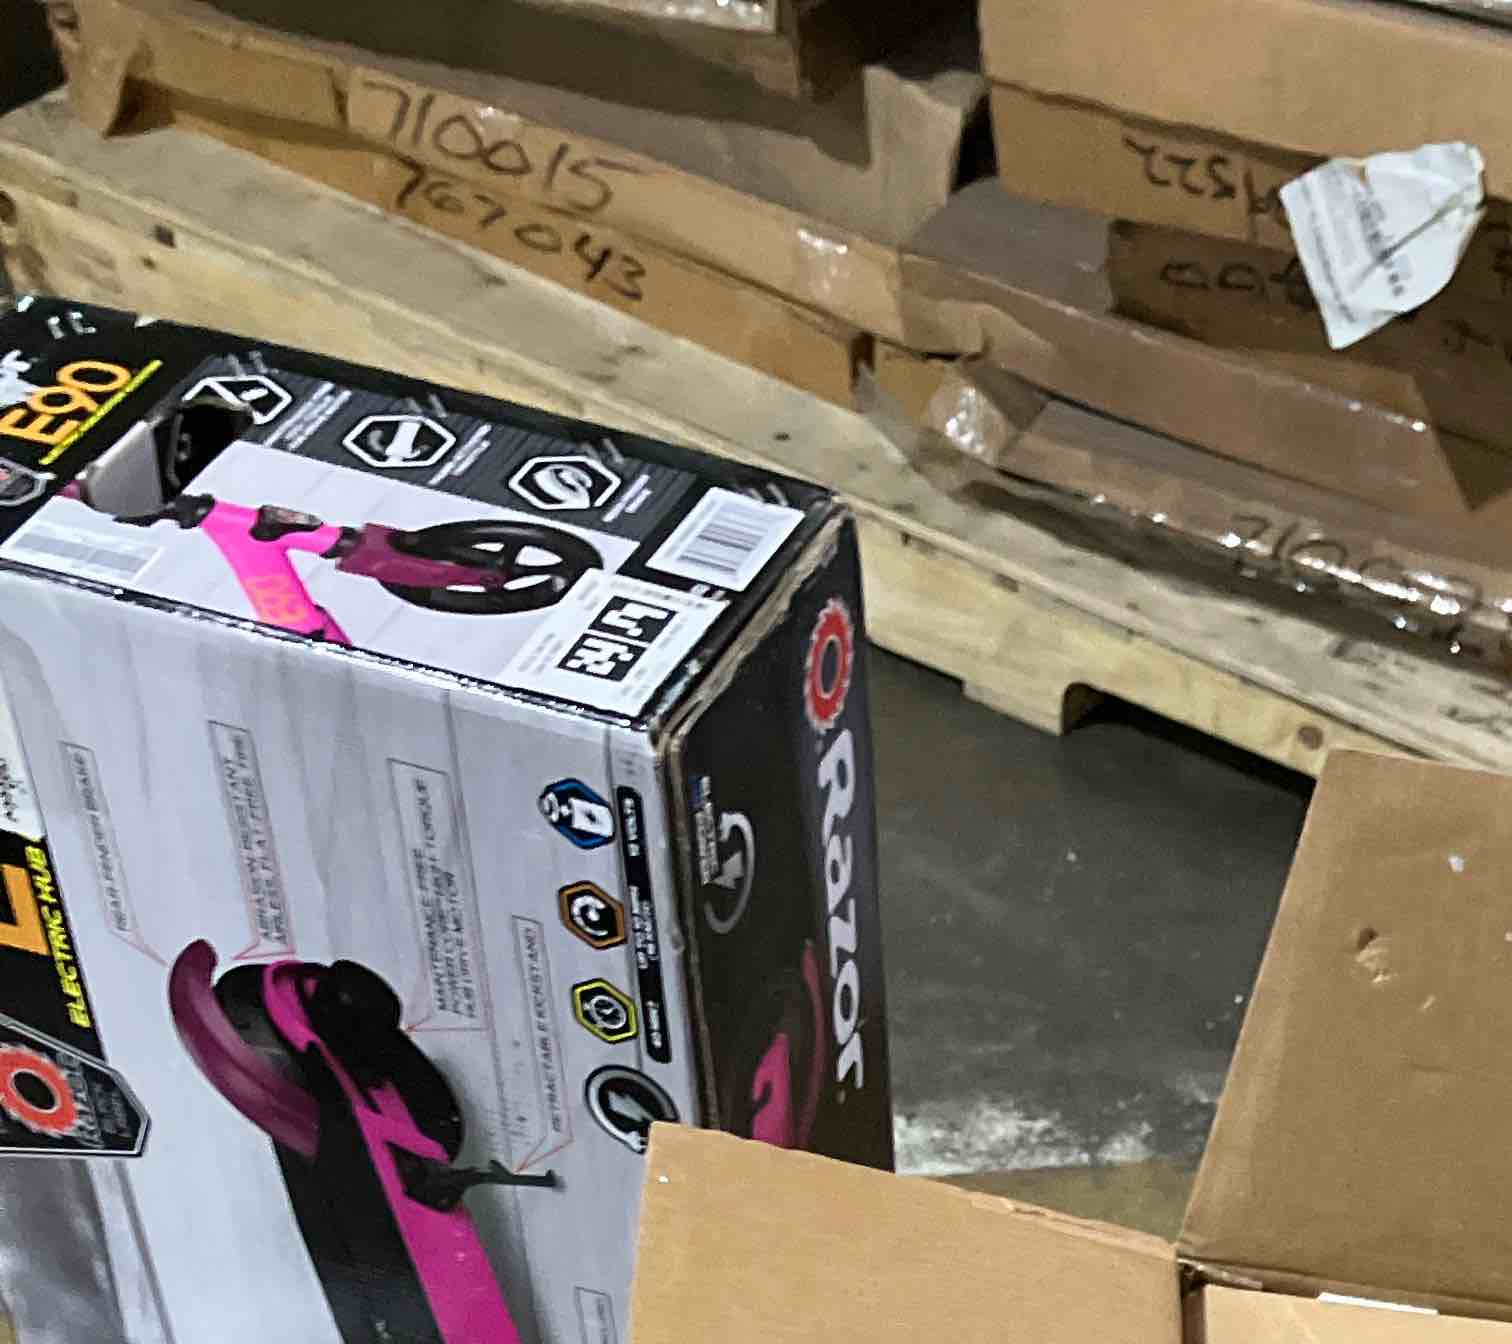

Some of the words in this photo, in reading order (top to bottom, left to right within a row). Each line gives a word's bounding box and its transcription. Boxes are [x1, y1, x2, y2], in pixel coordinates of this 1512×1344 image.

[362, 78, 652, 214] 710015
[394, 150, 648, 302] 767043
[0, 359, 131, 446] E90
[25, 845, 59, 904] HUB
[819, 729, 864, 1089] Razor
[40, 904, 92, 1029] ELECTRIC
